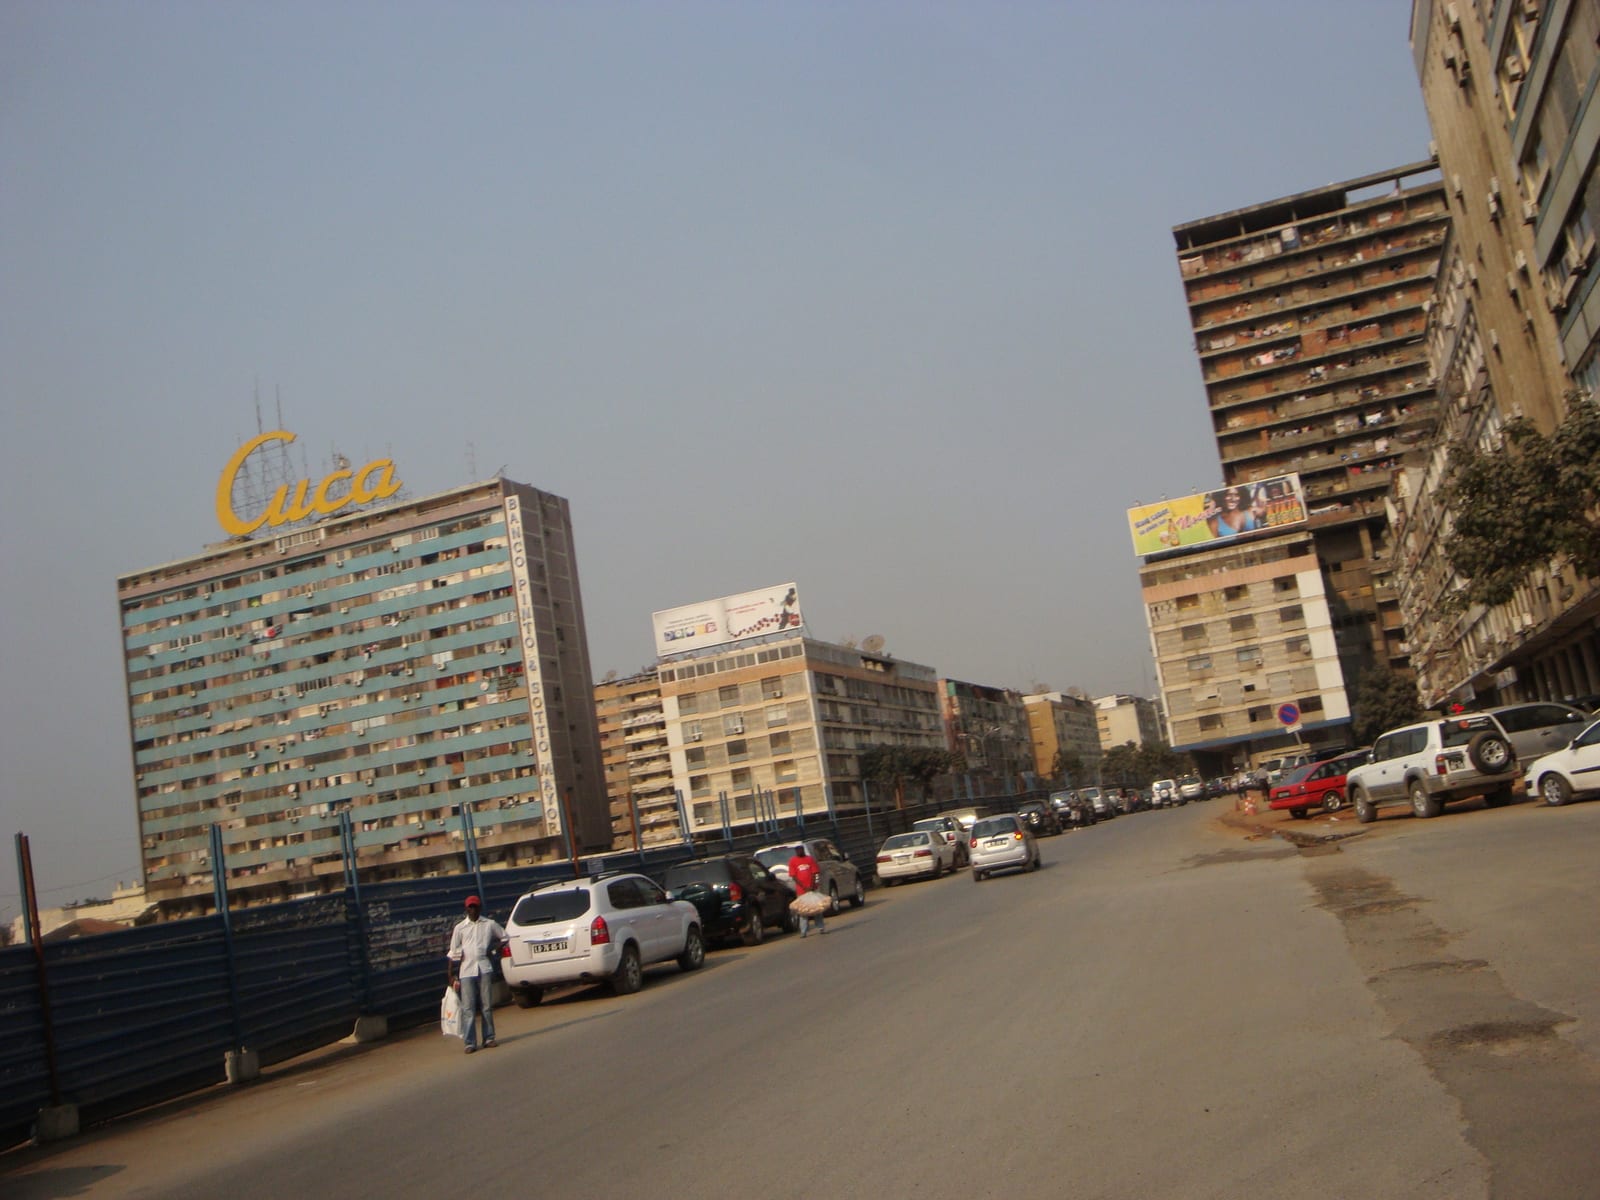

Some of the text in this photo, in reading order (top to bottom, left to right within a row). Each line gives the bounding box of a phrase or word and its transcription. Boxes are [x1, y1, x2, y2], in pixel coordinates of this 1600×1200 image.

[215, 430, 403, 536] Cuca
[509, 499, 525, 568] BANCO
[519, 579, 535, 649] PINTO
[531, 682, 549, 753] SOTTO
[541, 763, 560, 835] MAYOR
